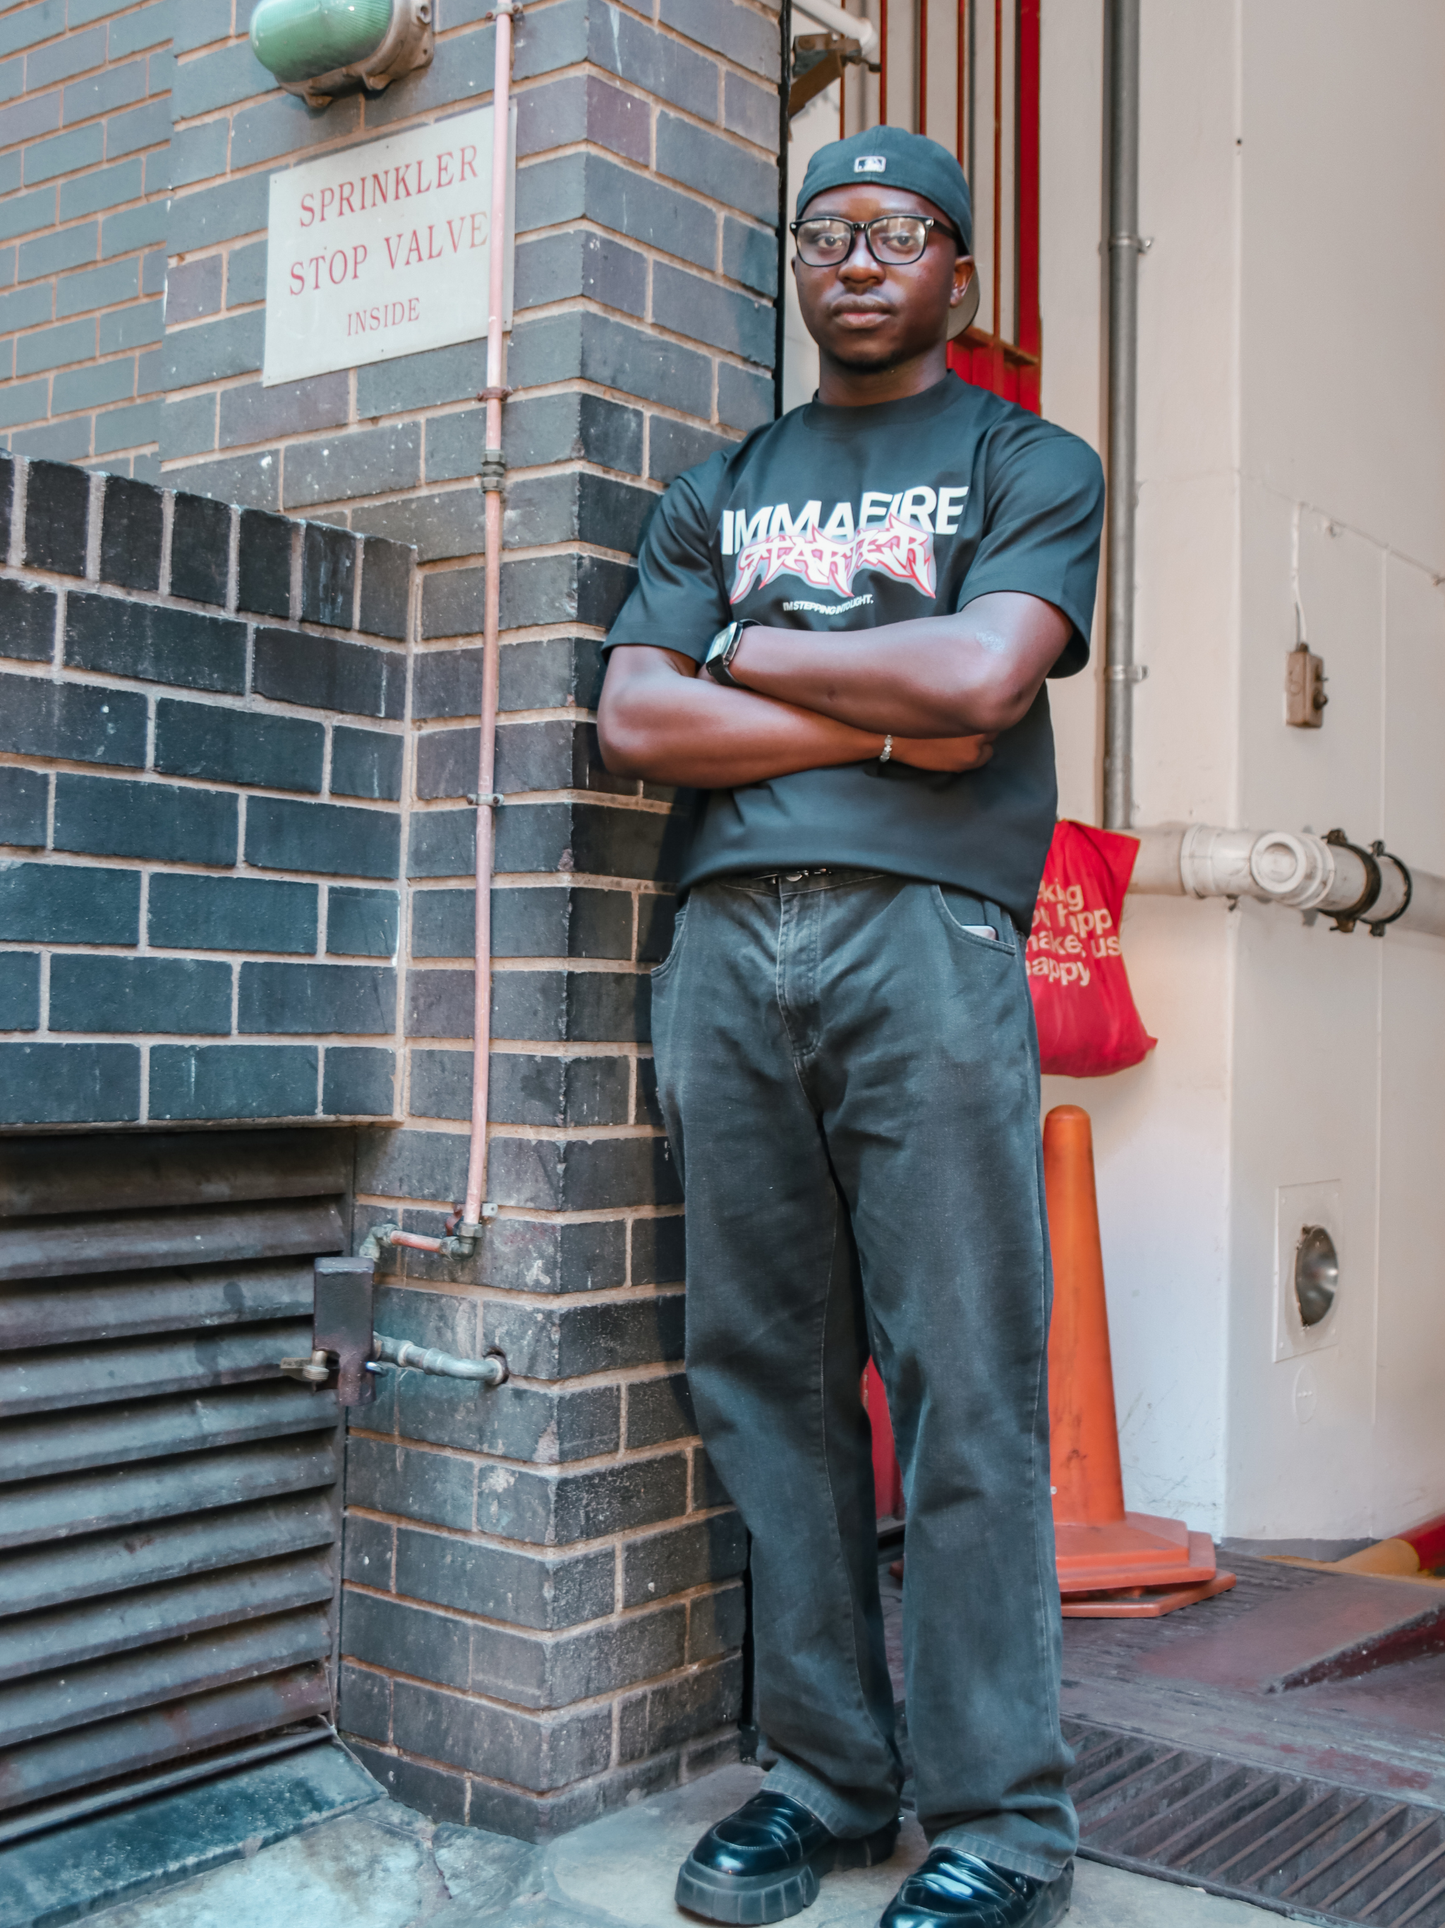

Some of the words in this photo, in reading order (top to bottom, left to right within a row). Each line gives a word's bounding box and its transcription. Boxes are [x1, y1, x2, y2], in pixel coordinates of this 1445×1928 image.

[299, 145, 479, 228] SPRINKLER
[289, 244, 368, 296] STOP
[384, 211, 489, 270] VALVE
[347, 297, 421, 337] INSIDE
[730, 512, 936, 605] STARTER
[1090, 936, 1121, 959] us
